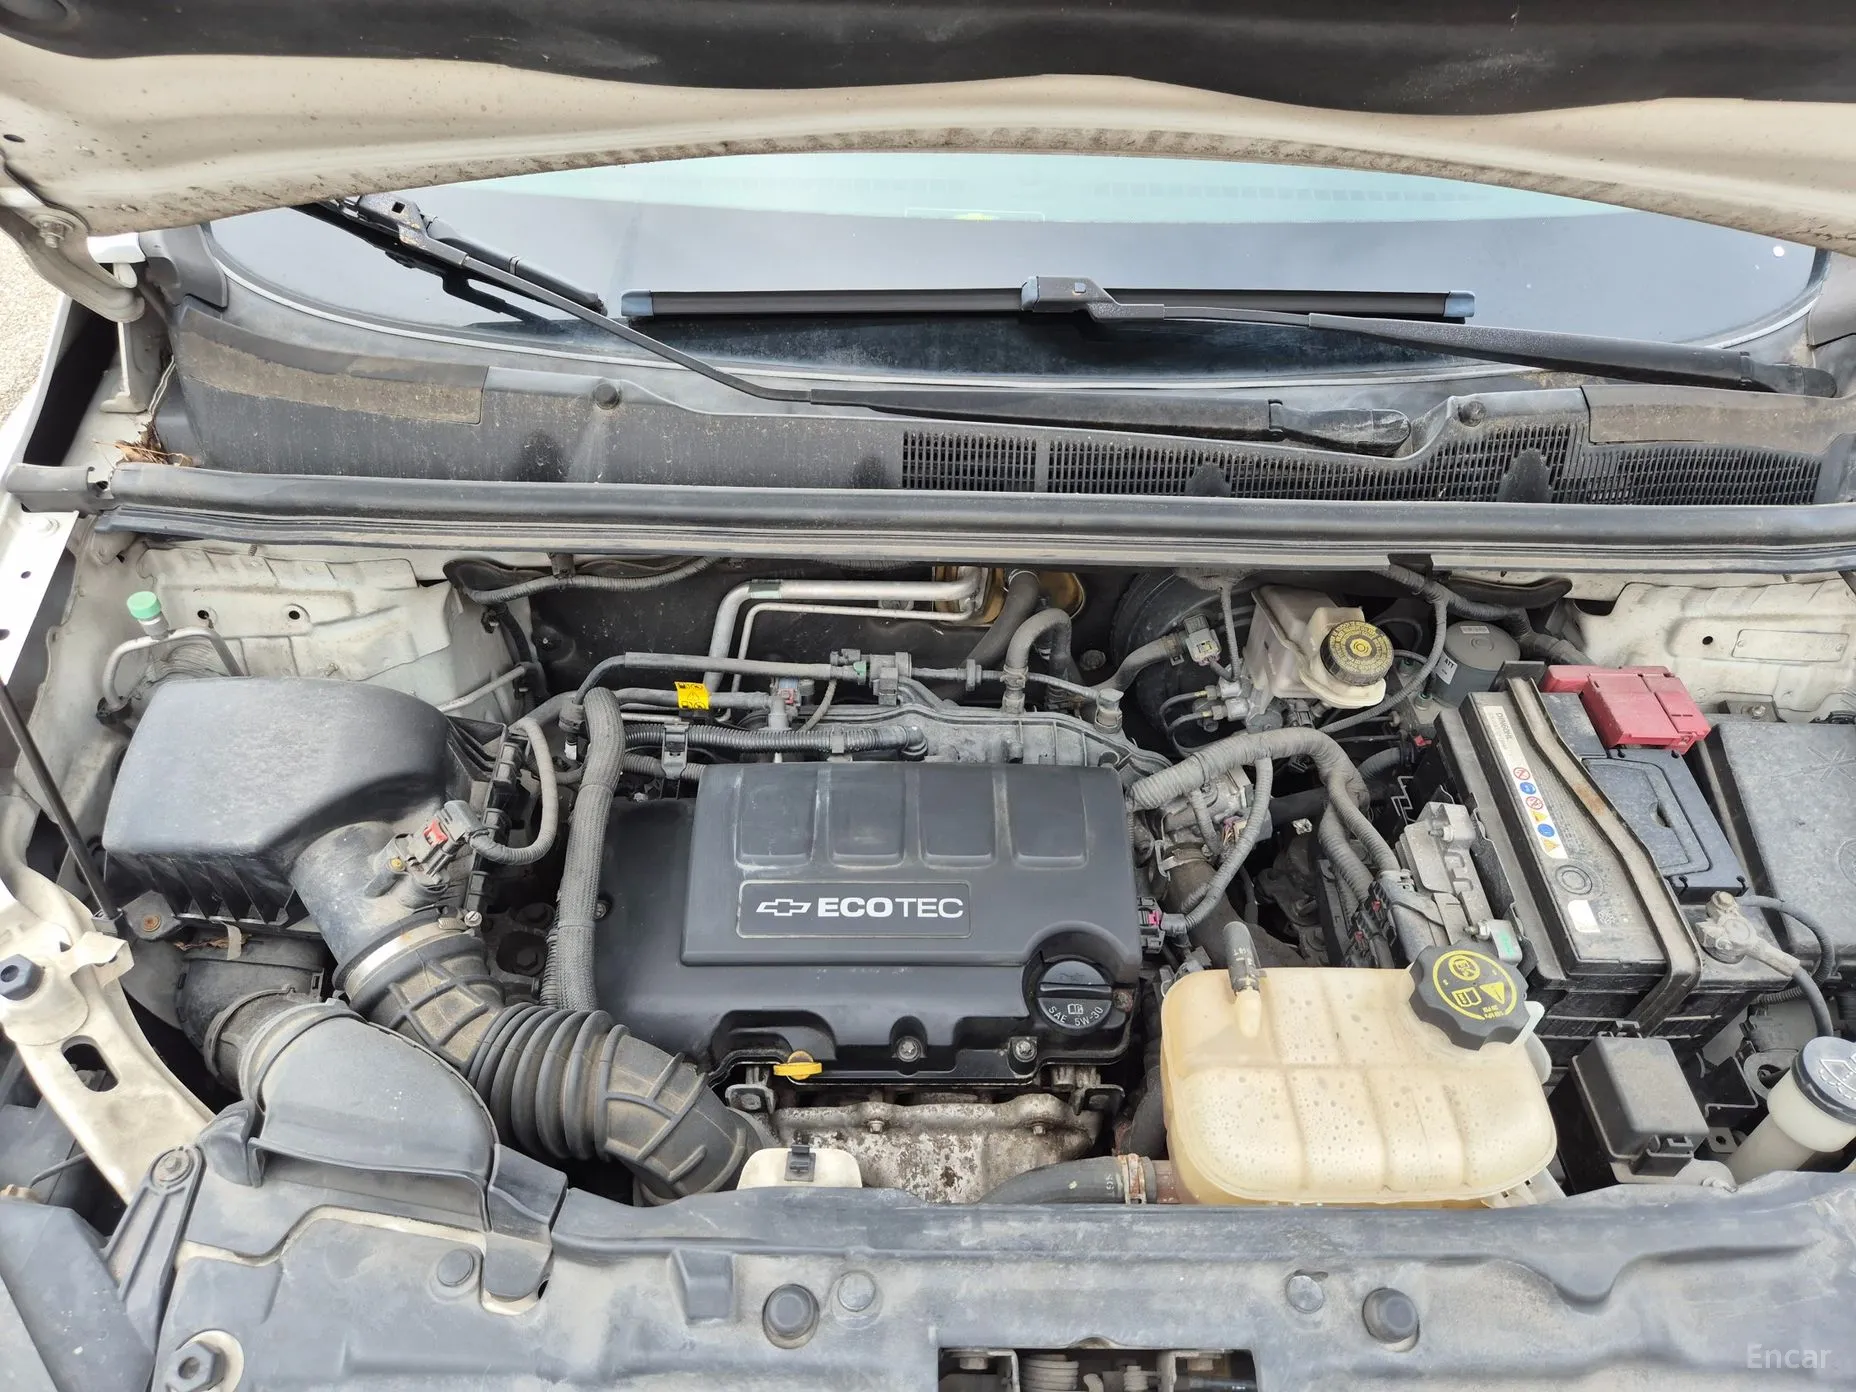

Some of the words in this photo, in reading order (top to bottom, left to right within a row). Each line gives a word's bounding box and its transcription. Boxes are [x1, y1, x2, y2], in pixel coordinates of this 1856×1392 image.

[817, 897, 964, 918] ECOTEC
[1048, 1005, 1068, 1024] SAE
[1074, 1006, 1104, 1027] 5W-30
